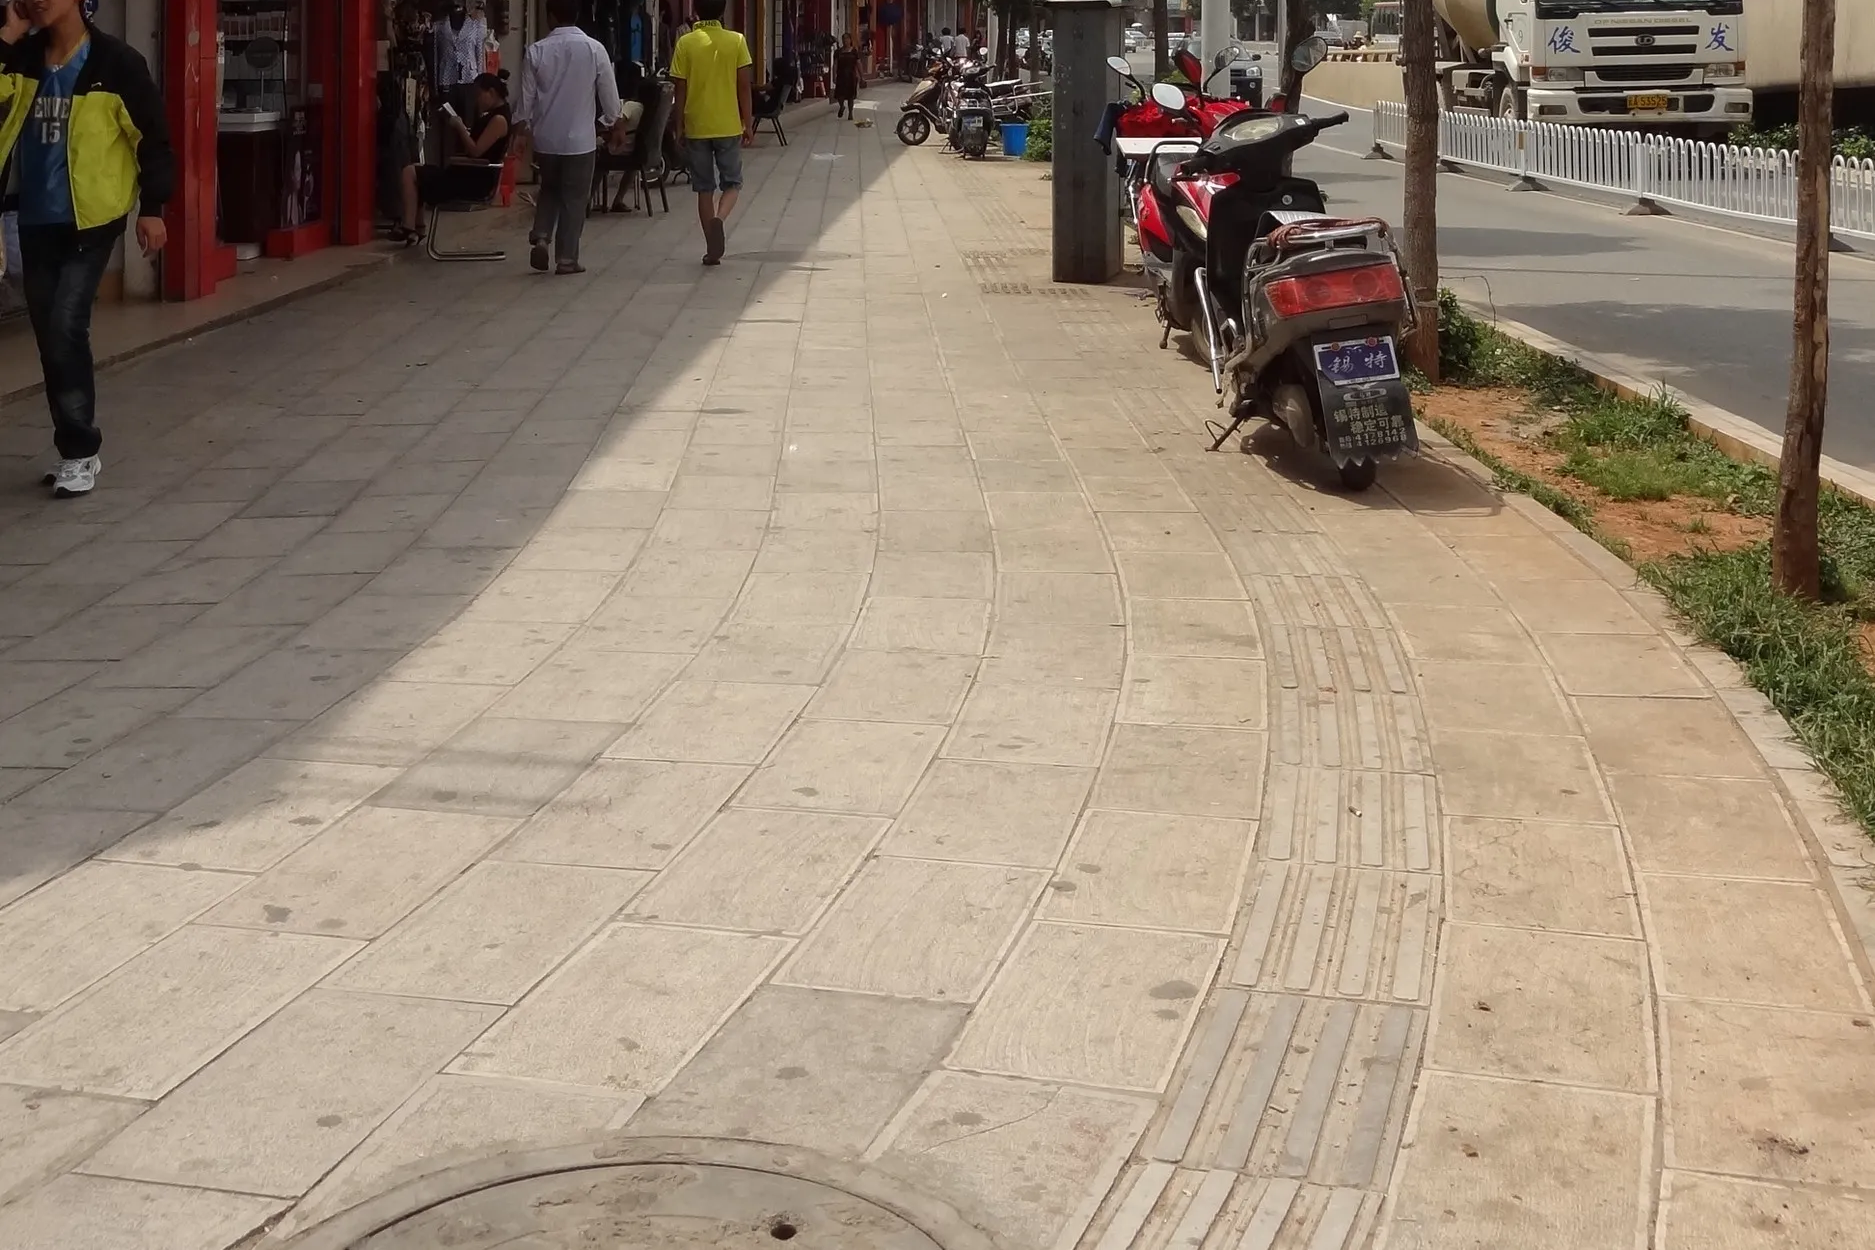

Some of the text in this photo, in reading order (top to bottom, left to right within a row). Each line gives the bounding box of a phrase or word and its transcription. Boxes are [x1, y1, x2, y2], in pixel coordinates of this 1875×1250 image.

[1547, 25, 1581, 55] 俊
[1705, 22, 1734, 52] 发
[41, 121, 61, 144] 15
[1327, 350, 1388, 374] 锡特
[1333, 403, 1388, 423] 锡特制造
